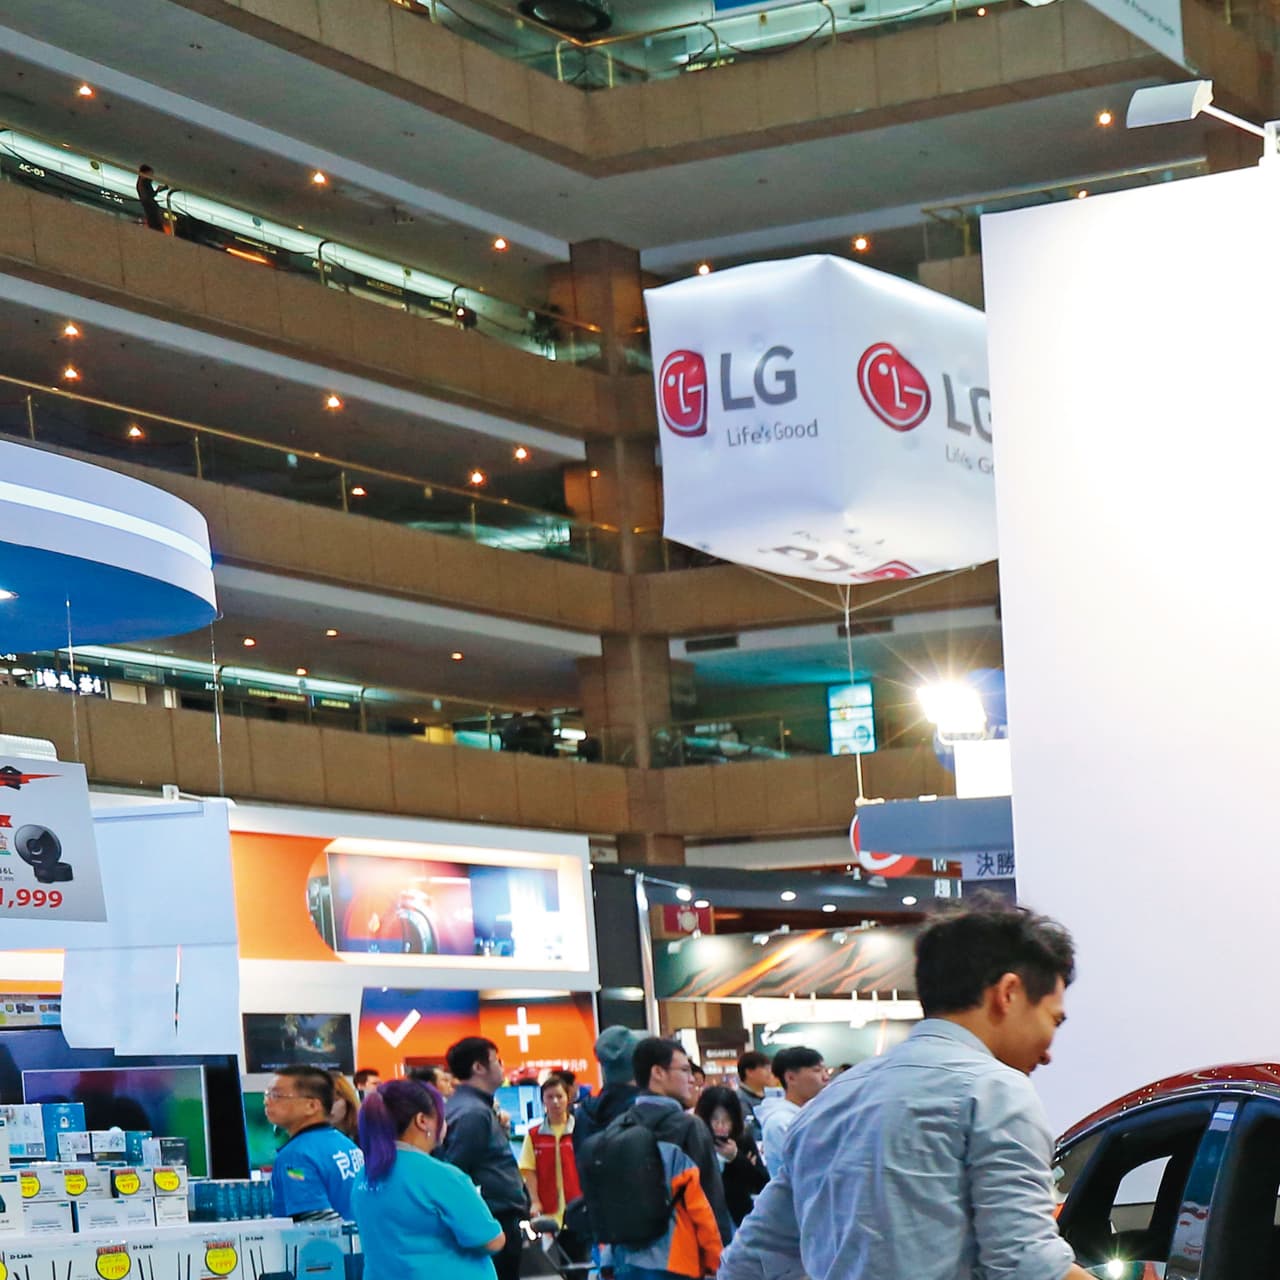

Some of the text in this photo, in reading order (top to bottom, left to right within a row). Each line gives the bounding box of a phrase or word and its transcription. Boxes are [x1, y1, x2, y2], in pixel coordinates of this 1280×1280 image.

[720, 345, 798, 412] LG
[727, 418, 819, 447] Life's Good
